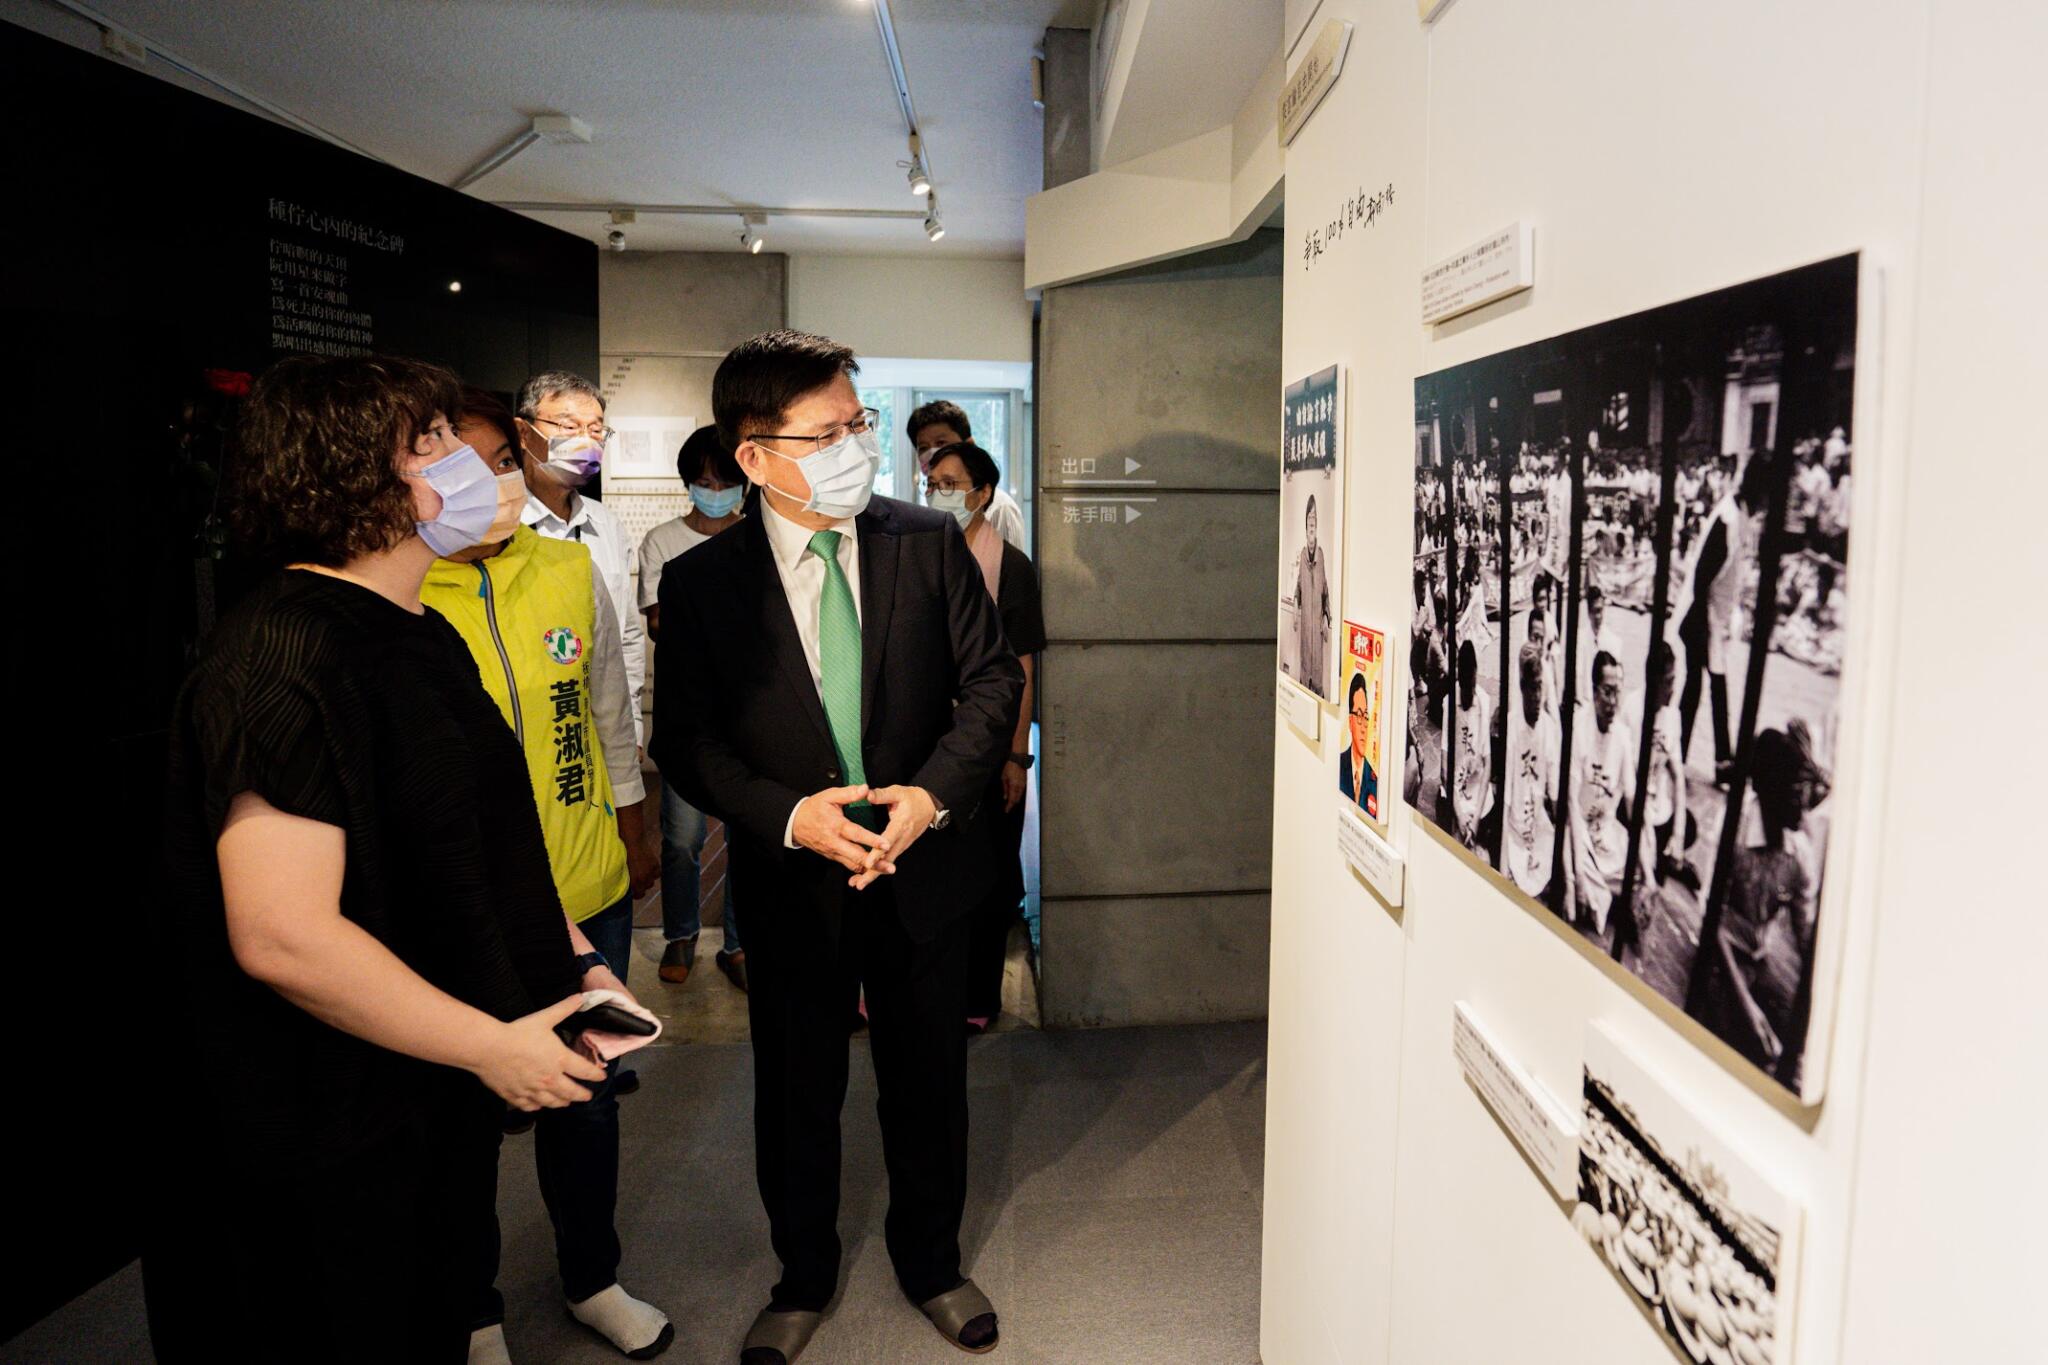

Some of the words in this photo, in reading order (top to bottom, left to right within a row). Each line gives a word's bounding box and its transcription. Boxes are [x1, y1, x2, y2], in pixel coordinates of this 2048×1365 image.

[1061, 457, 1097, 475] 出口
[1063, 506, 1117, 524] 洗手間
[549, 678, 586, 807] 黃淑君
